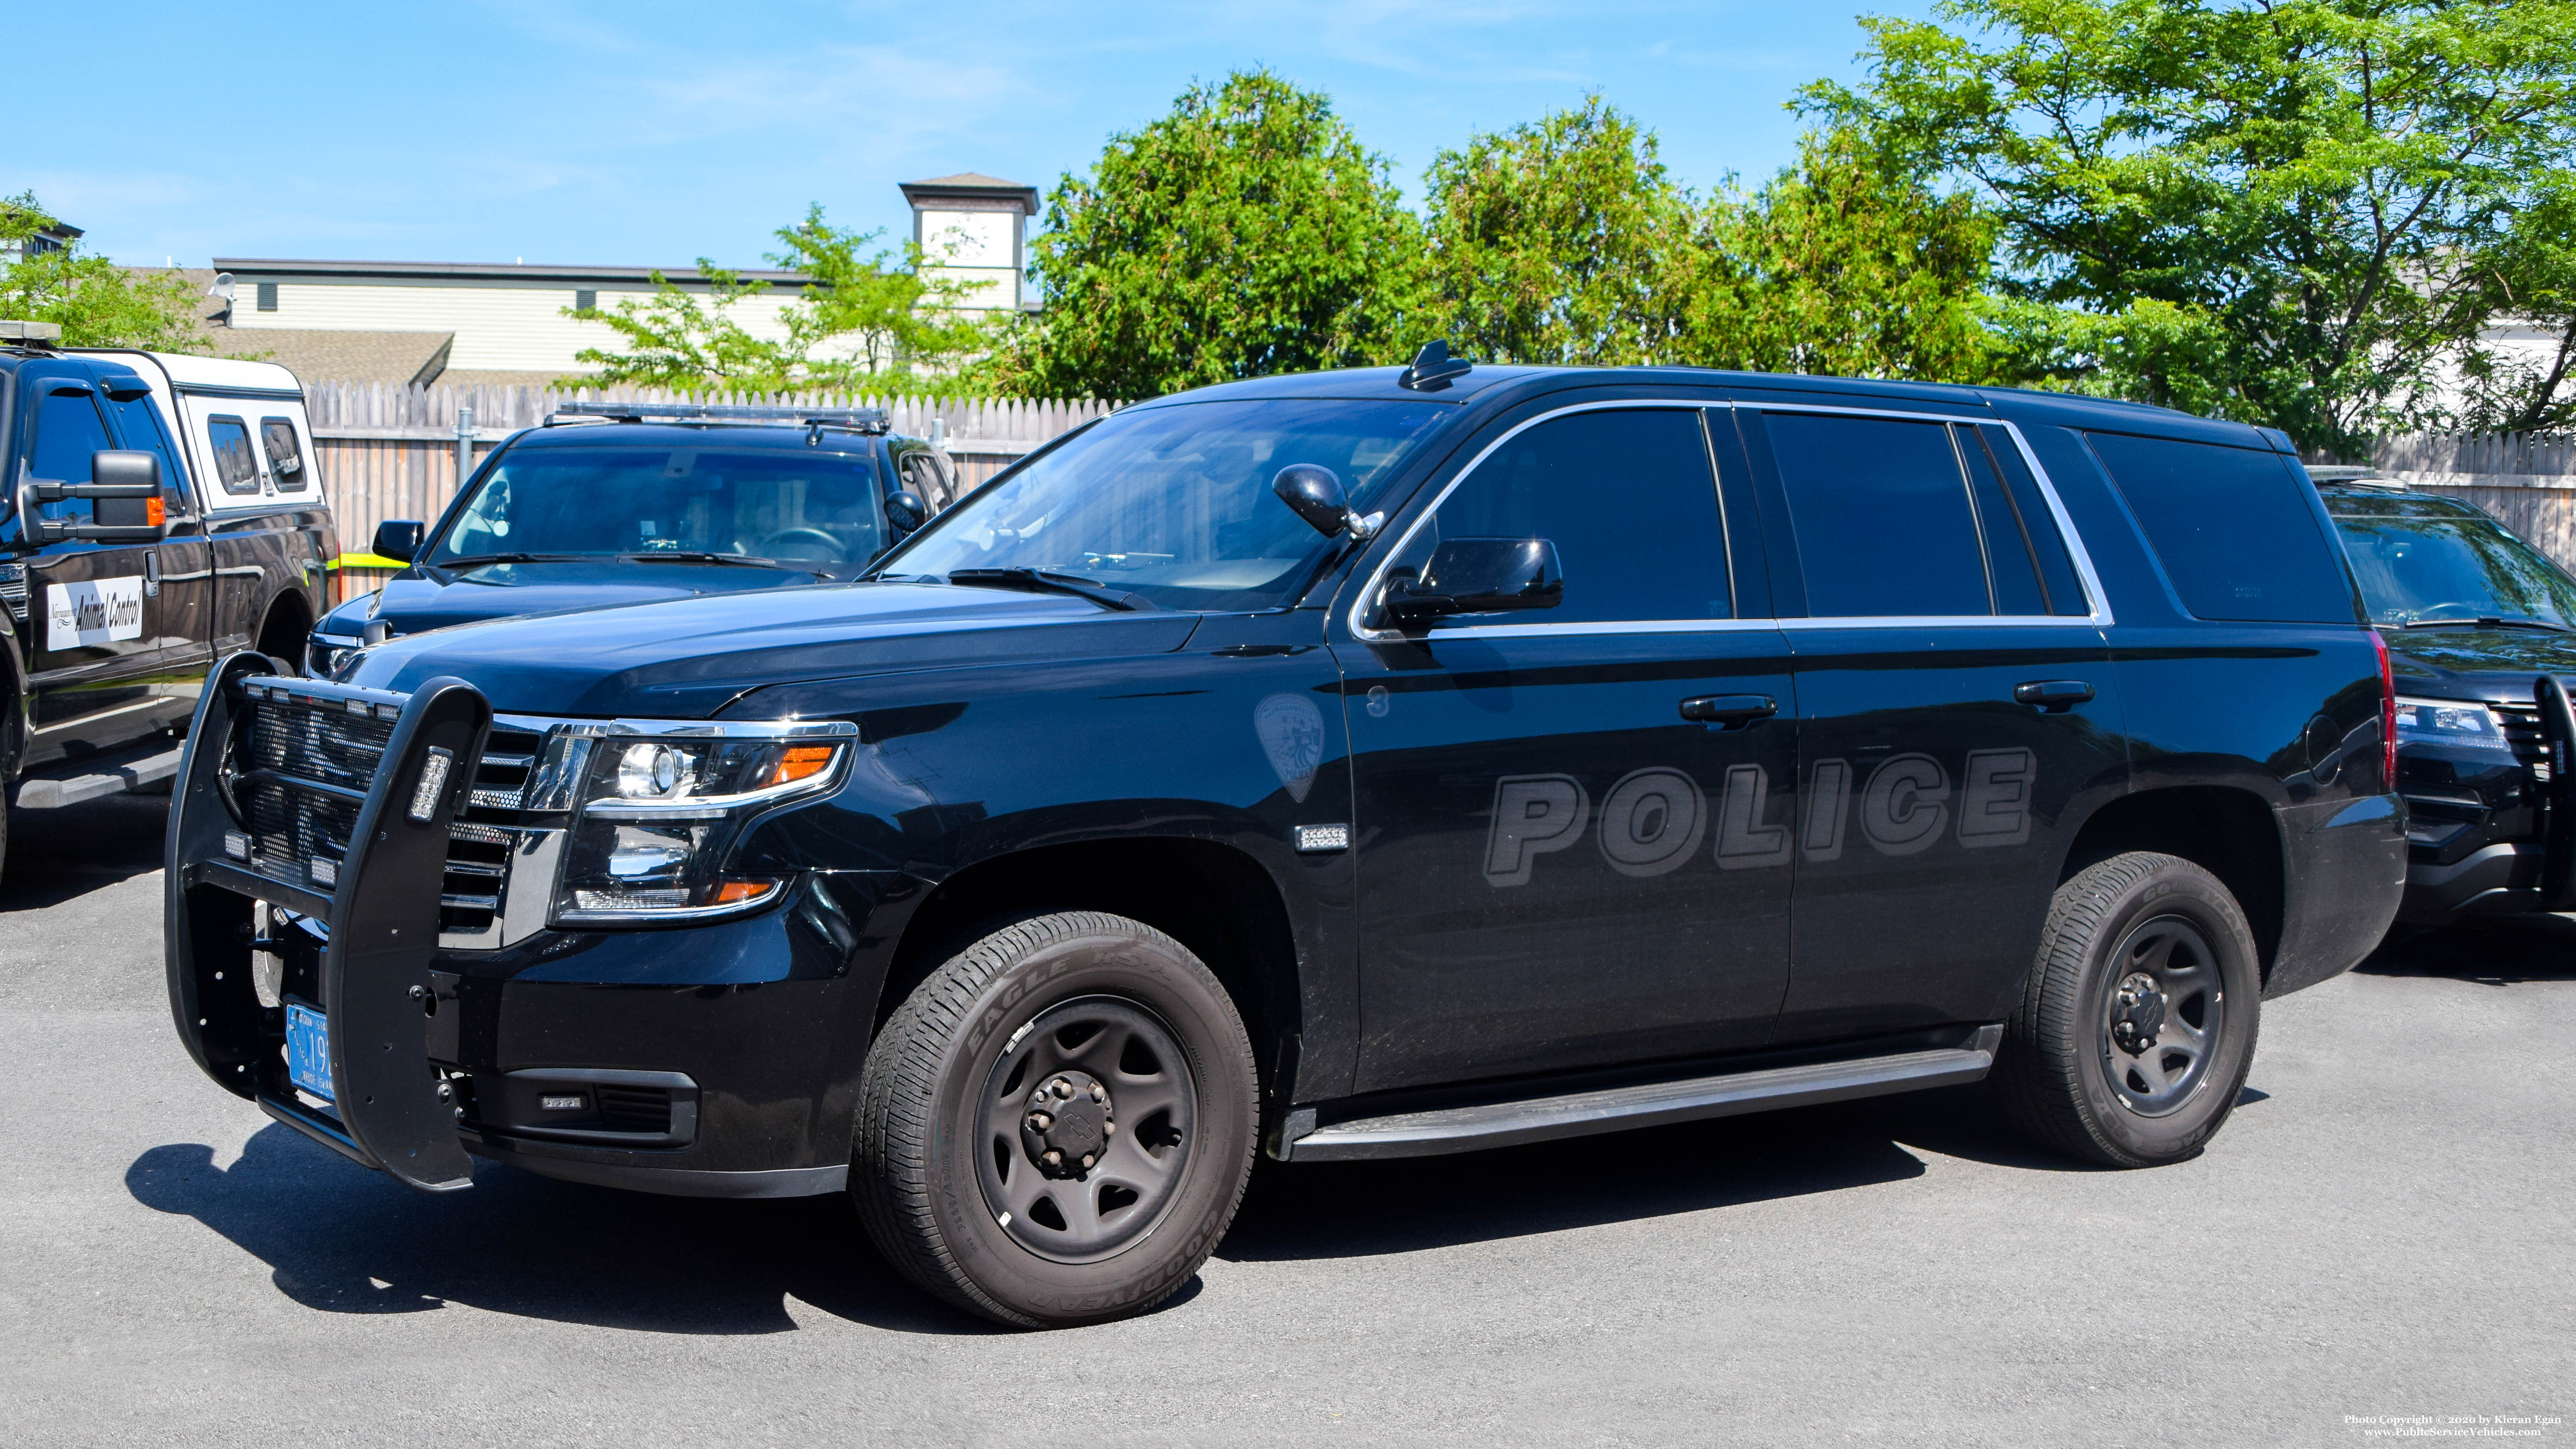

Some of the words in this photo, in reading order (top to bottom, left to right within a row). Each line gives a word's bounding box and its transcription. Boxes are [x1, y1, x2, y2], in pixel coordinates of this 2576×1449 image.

[75, 593, 109, 632] Animal
[109, 590, 141, 628] Control
[1367, 685, 1389, 717] 3
[1484, 747, 2037, 887] POLICE
[968, 957, 1071, 1057] EAGLE
[1028, 1210, 1218, 1311] GOODYEAR
